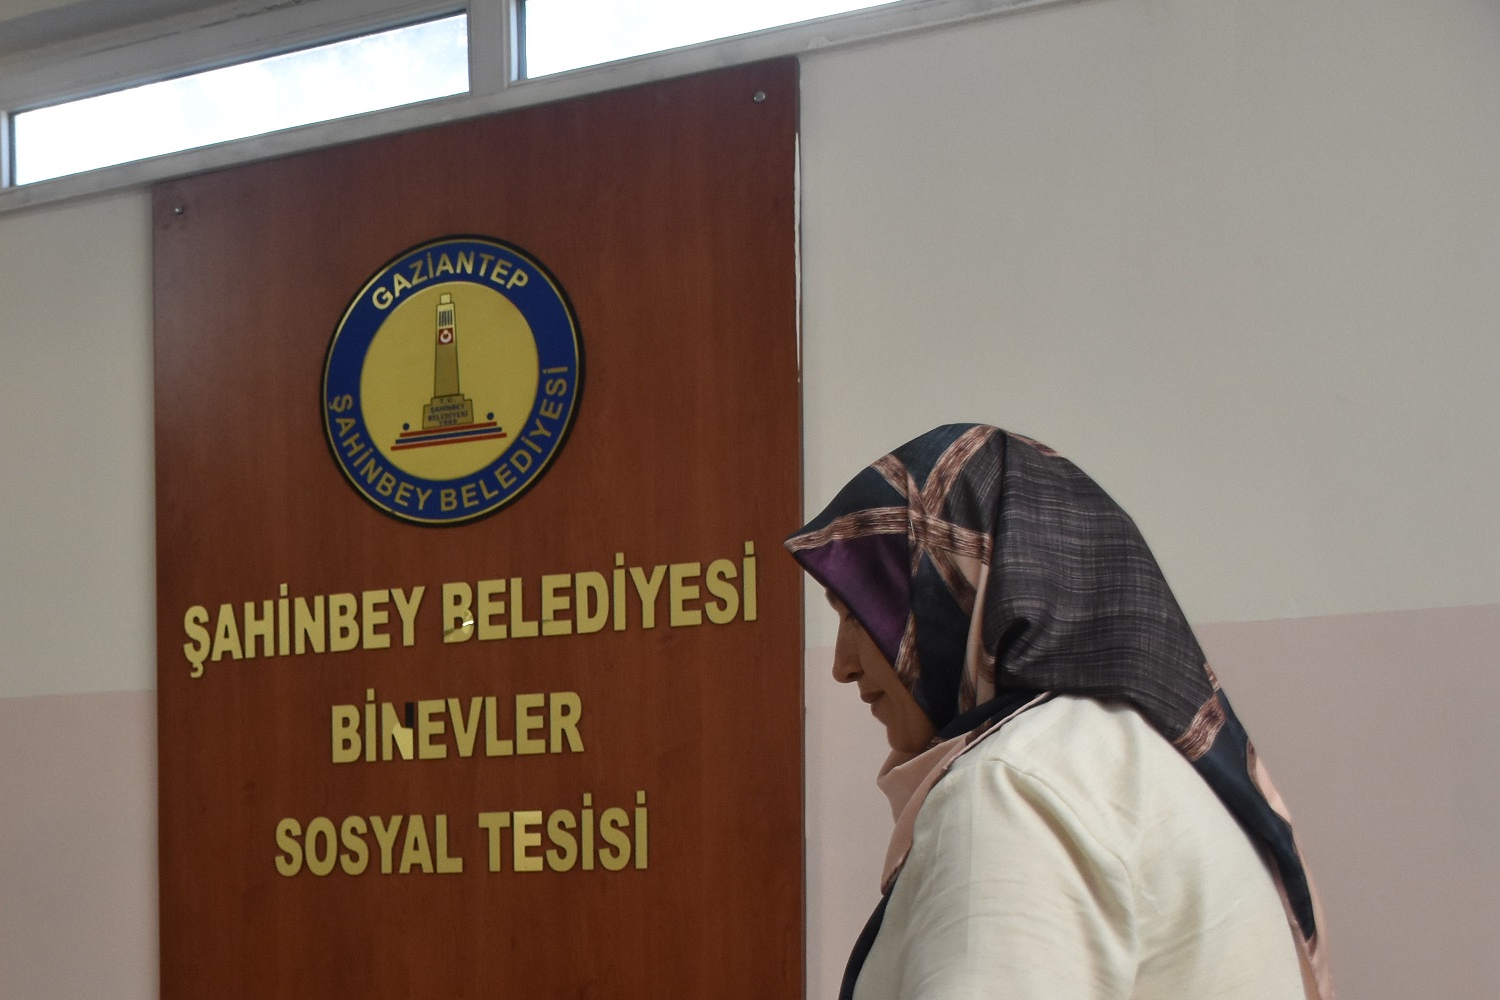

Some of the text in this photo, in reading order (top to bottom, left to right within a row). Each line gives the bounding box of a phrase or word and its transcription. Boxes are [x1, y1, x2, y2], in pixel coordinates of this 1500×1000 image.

[372, 251, 529, 310] GAZİANTEP
[329, 366, 568, 511] ŞAHİNBEY BELEDİYESİ
[183, 540, 757, 678] ŞAHİNBEY BELEDİYESİ
[331, 688, 584, 763] BİNEVLER
[275, 790, 648, 877] SOSYAL TESİSİ
